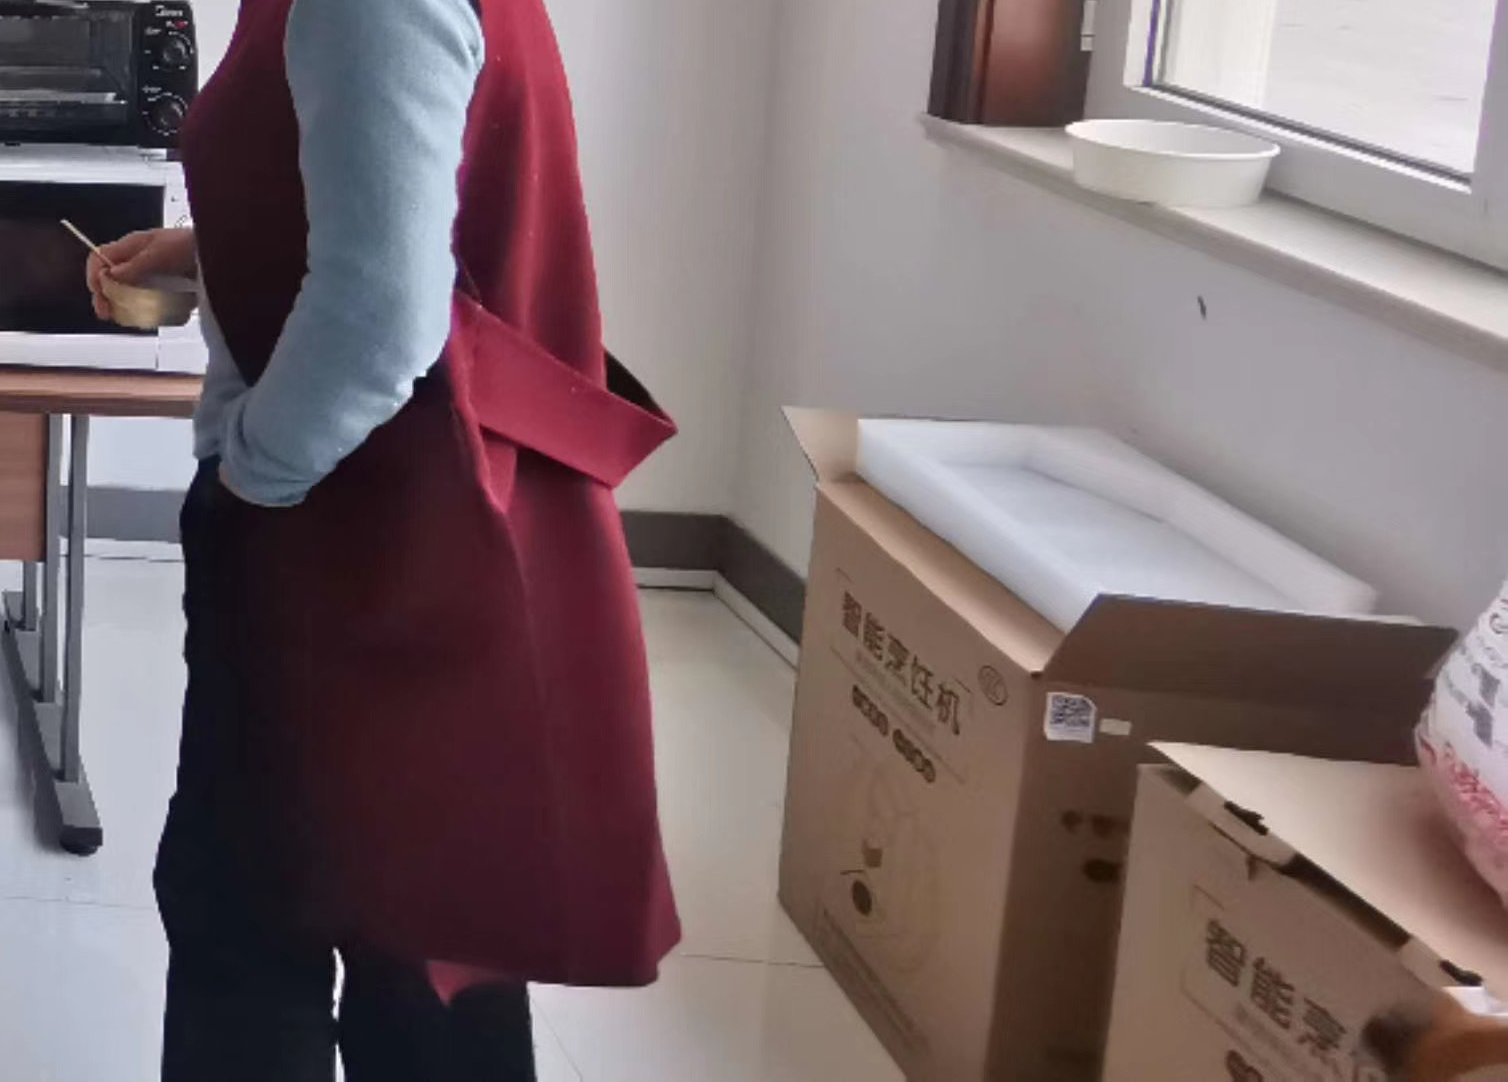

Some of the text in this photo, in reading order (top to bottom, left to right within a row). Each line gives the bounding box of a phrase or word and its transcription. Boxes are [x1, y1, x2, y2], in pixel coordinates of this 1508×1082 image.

[842, 591, 960, 735] 智能烹饪机
